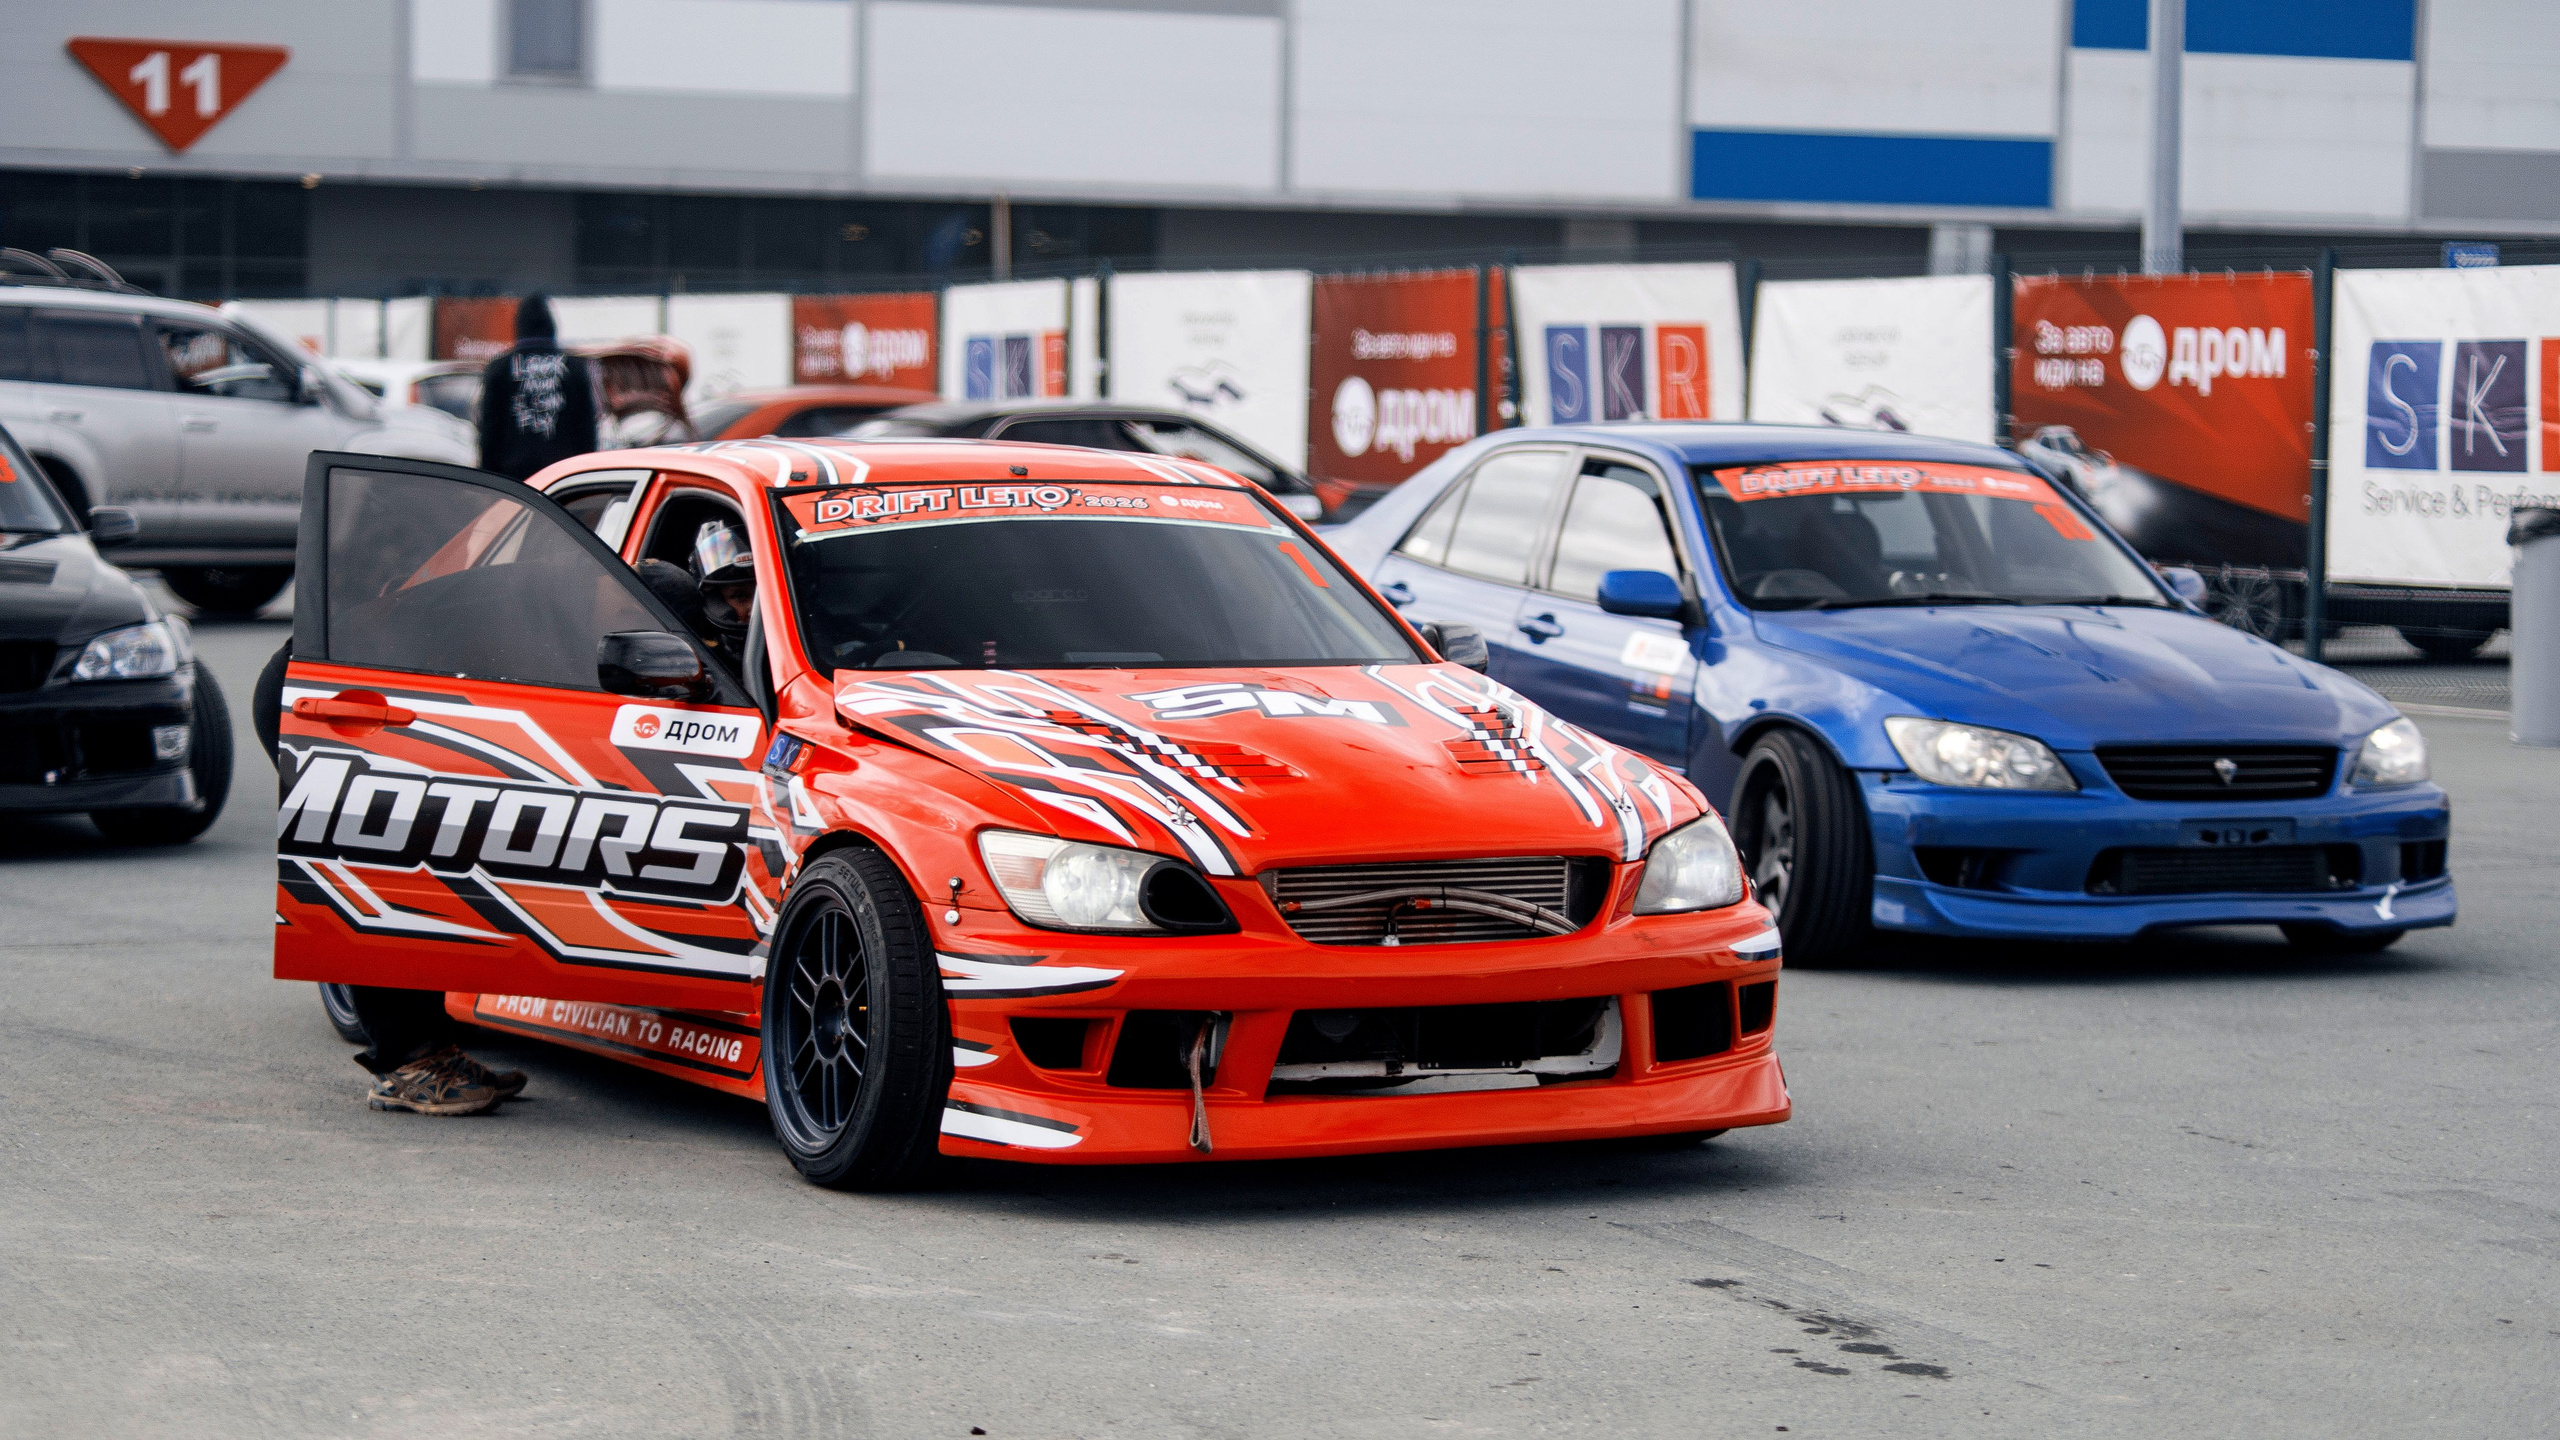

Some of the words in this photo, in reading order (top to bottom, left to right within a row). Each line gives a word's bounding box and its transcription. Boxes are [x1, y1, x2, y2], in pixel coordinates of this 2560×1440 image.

[129, 51, 222, 118] 11
[2034, 319, 2064, 355] За
[2065, 326, 2114, 355] авто
[1549, 333, 1705, 420] SKR
[2168, 326, 2287, 397] дром
[1374, 388, 1476, 462] дром
[2377, 353, 2560, 457] SK
[1739, 467, 1838, 494] DRIFT
[1839, 466, 1922, 491] LETO
[2363, 480, 2446, 518] Service
[2452, 484, 2472, 517] &
[815, 487, 954, 524] DRIFT
[956, 485, 1072, 511] LETO
[1085, 494, 1150, 510] 2026
[1277, 541, 1330, 589] 1
[1130, 683, 1389, 724] SM
[664, 719, 740, 746] дром
[770, 738, 810, 770] SKR
[496, 994, 548, 1019] FROM
[551, 1001, 631, 1037] CIVILIAN
[638, 1020, 673, 1044] TO
[668, 1027, 743, 1063] RACING
